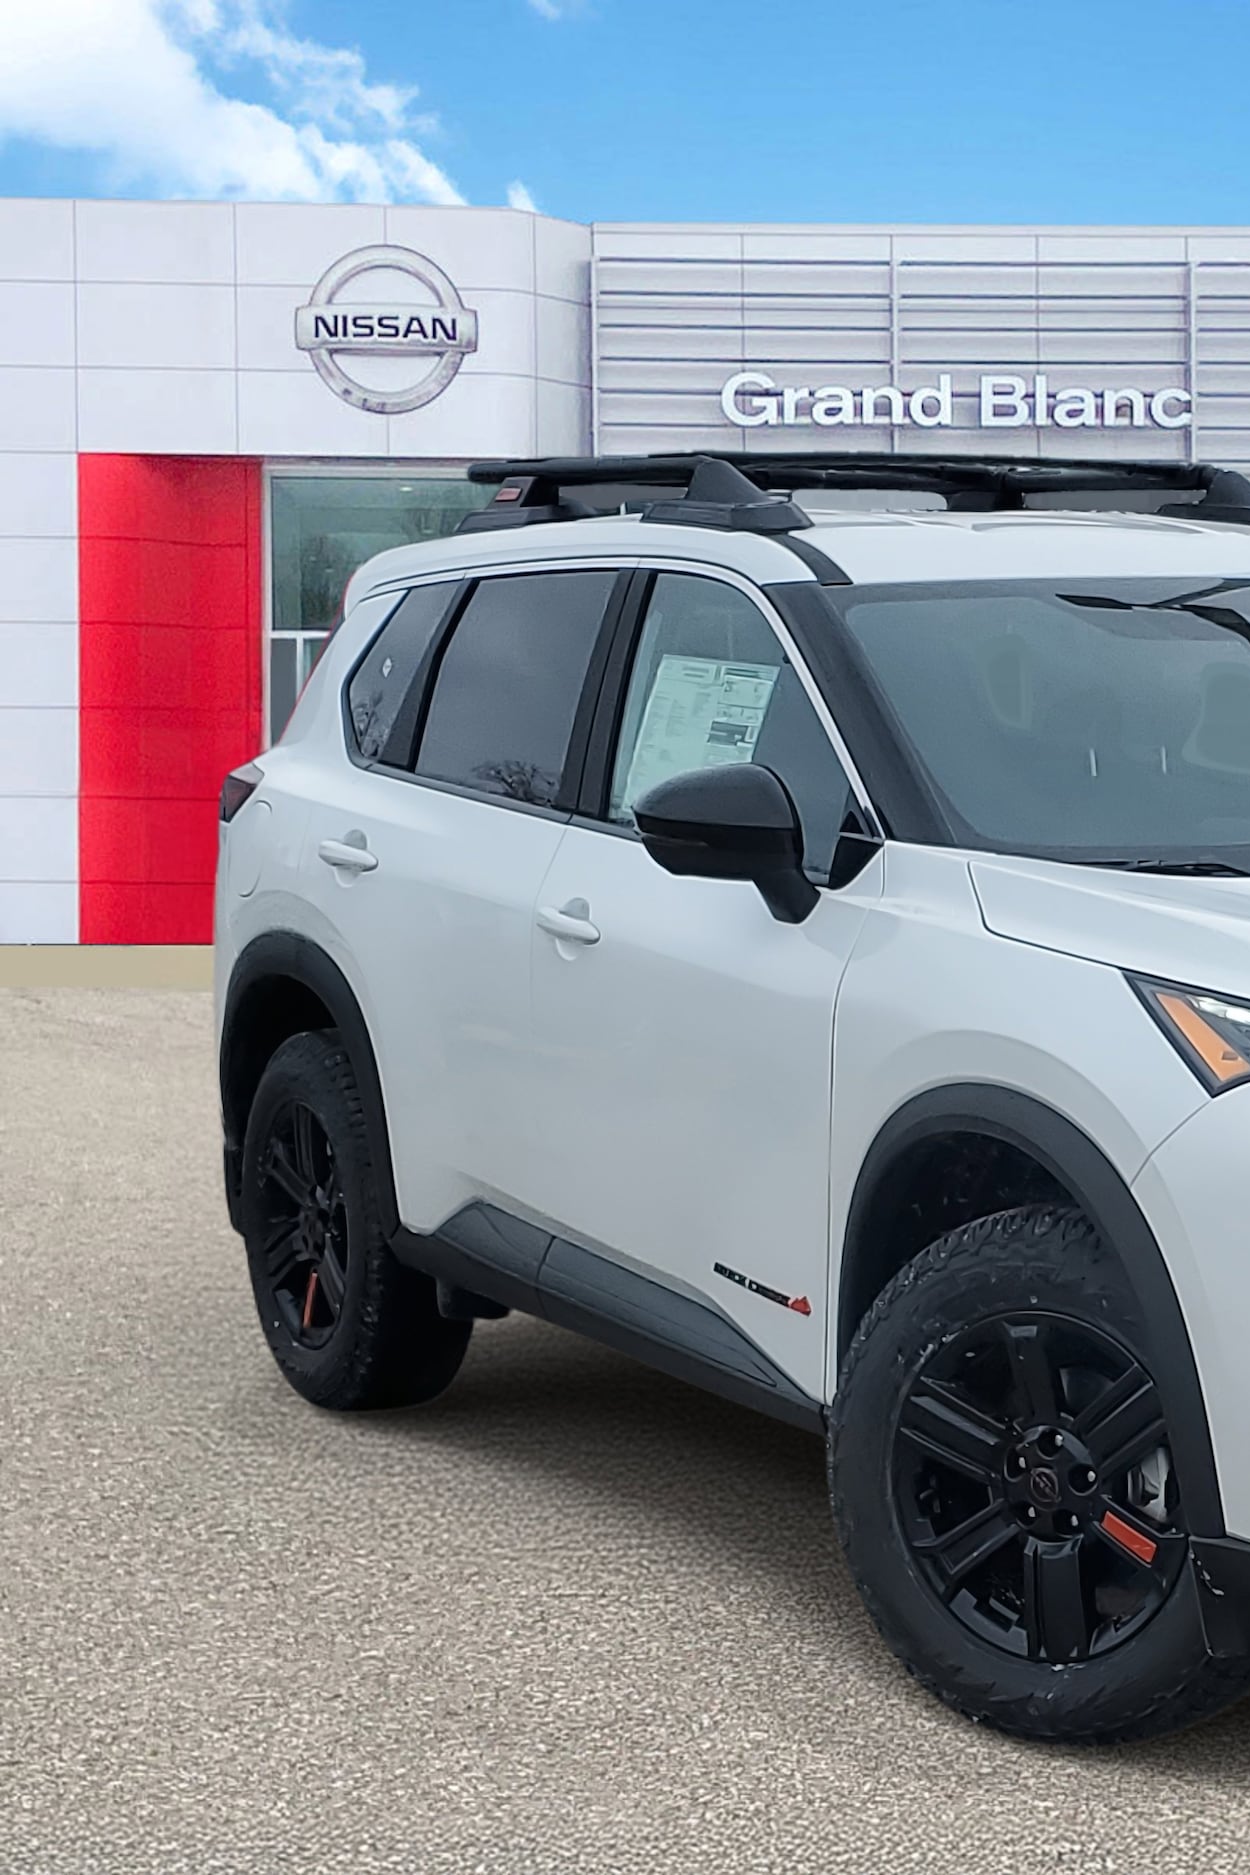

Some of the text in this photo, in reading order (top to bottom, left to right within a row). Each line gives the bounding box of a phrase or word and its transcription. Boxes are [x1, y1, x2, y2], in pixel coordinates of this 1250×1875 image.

[314, 314, 457, 341] NISSAN
[721, 372, 1193, 429] Grand Blanc
